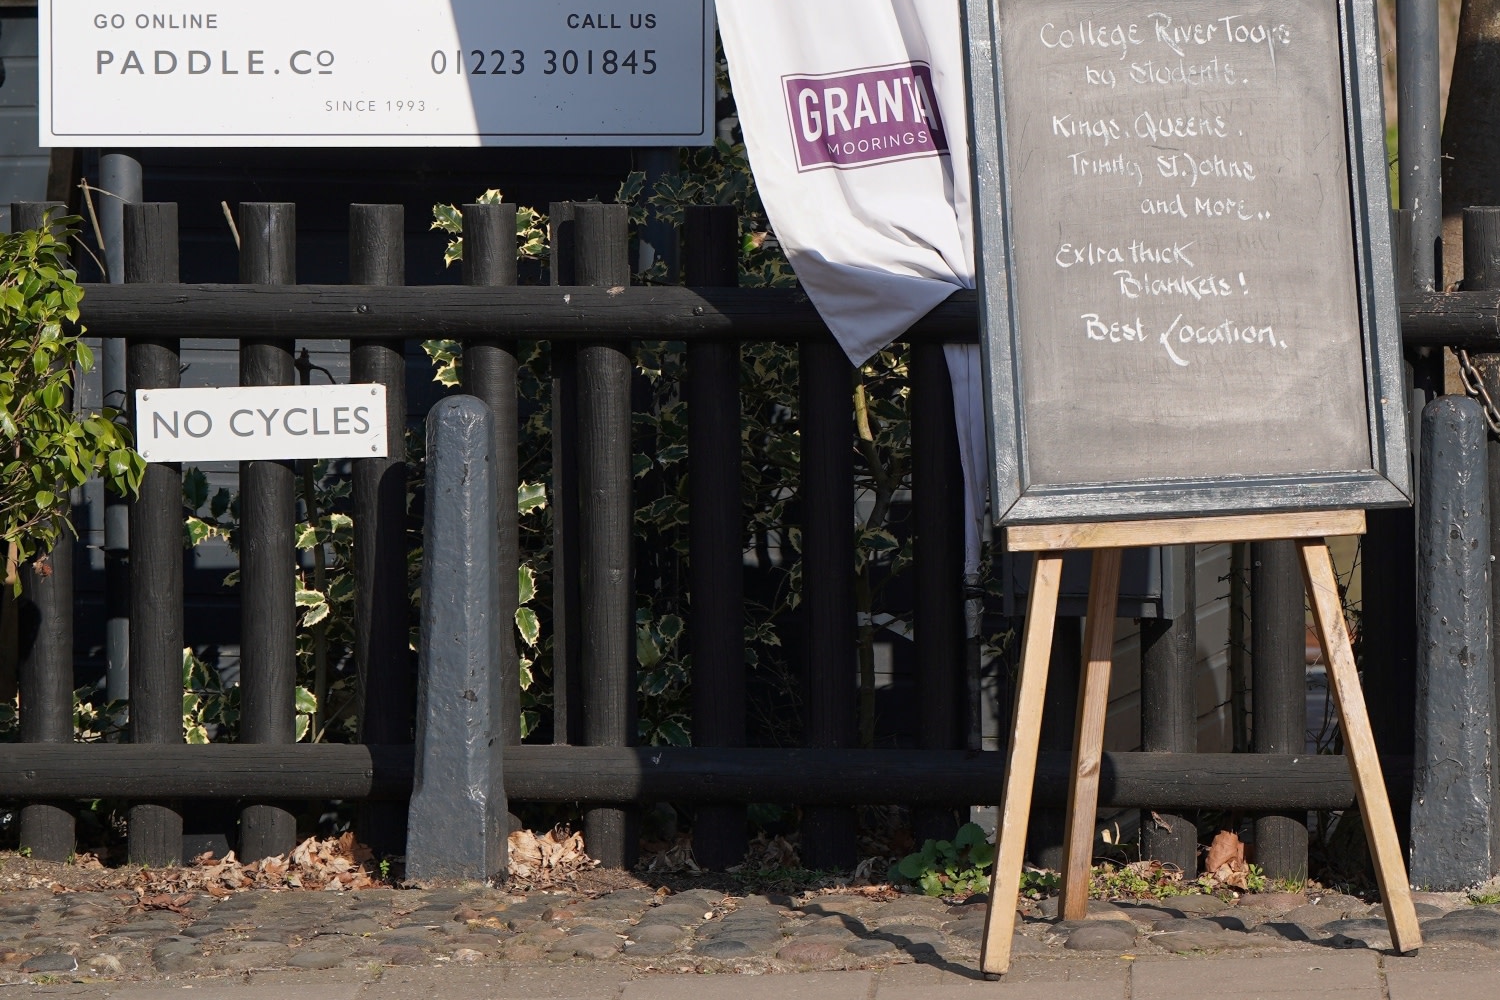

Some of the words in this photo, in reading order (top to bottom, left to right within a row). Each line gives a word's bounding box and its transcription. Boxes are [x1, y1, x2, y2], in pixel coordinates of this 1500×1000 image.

[93, 13, 127, 30] GO
[134, 13, 219, 30] ONLINE
[566, 13, 622, 30] CALL
[629, 13, 657, 30] US
[1040, 20, 1145, 61] College
[1147, 11, 1217, 57] River
[430, 49, 527, 76] 01223
[542, 49, 658, 76] 301845
[325, 100, 377, 113] SINCE
[385, 100, 427, 113] 1993
[798, 74, 939, 143] GRANTA
[826, 130, 928, 157] MOORINGS
[1141, 193, 1189, 218] and
[1055, 242, 1124, 268] Extra
[1080, 312, 1150, 343] Best
[152, 409, 213, 439] NO
[229, 406, 370, 437] CYCLES
